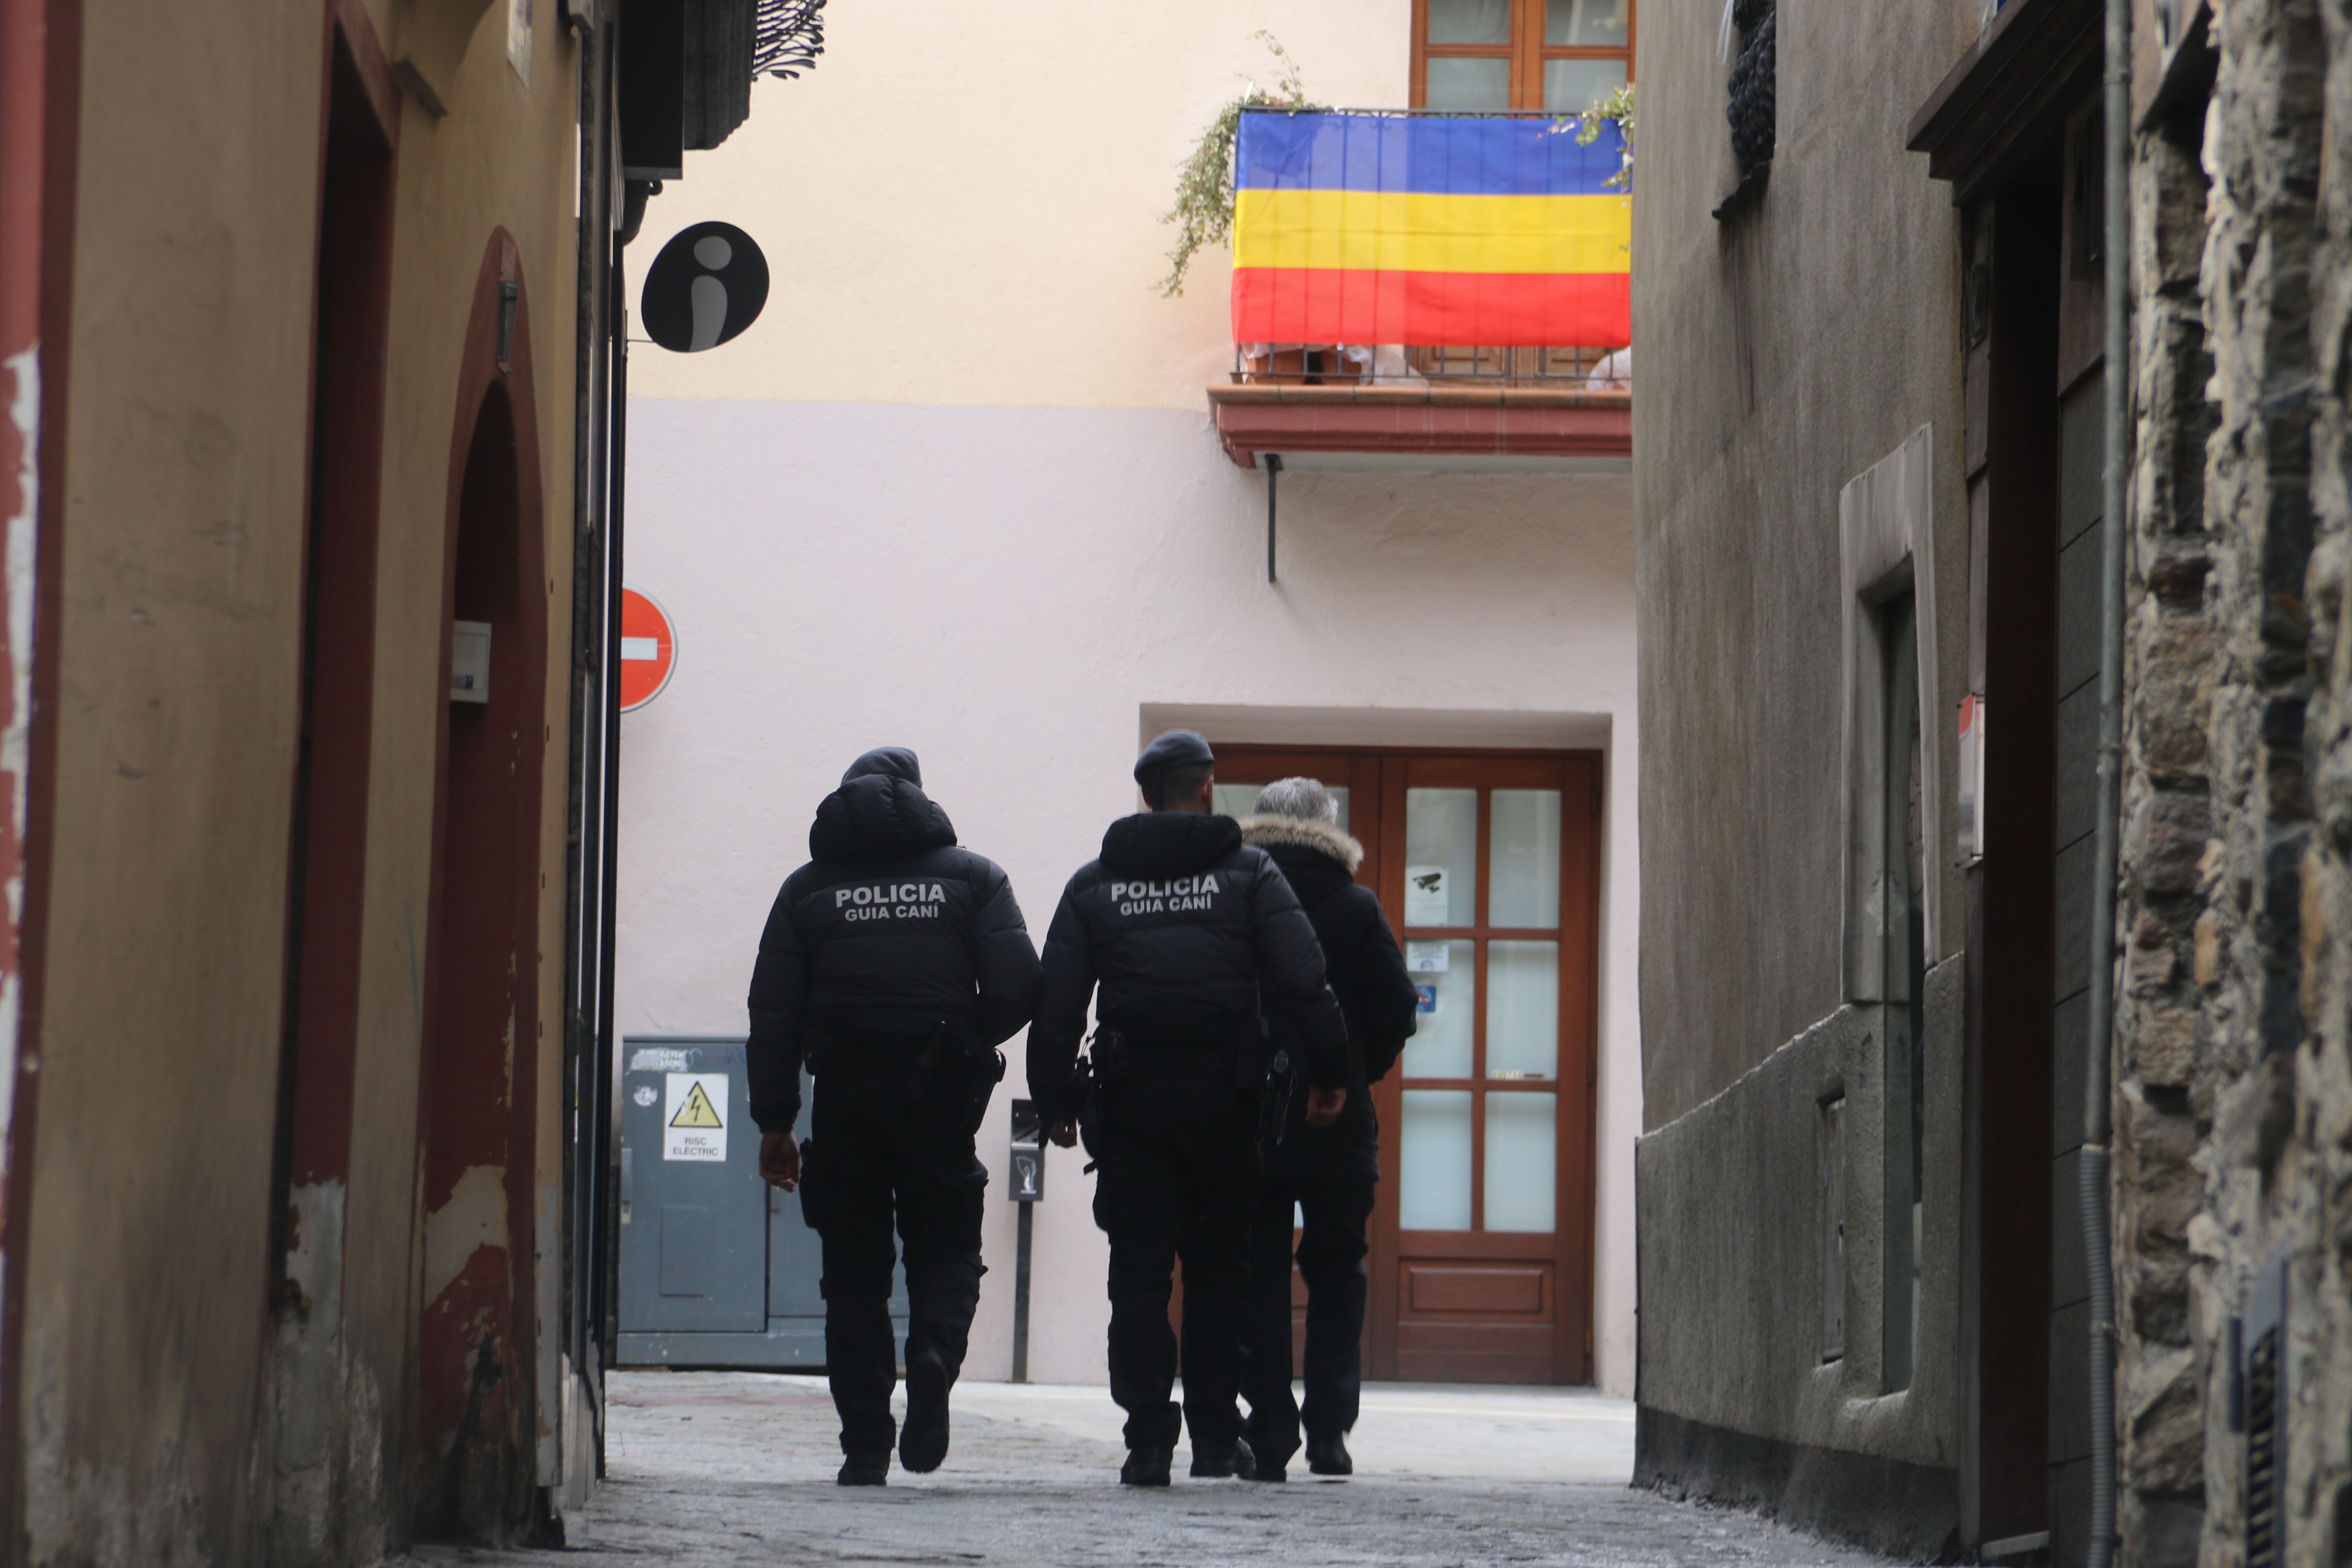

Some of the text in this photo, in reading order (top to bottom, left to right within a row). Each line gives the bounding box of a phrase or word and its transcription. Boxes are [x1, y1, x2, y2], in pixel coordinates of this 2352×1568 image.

[836, 884, 946, 908] POLICIA
[1112, 874, 1219, 902] POLICIA
[845, 906, 890, 922] GUIA
[1121, 898, 1164, 916] GUIA
[685, 1137, 707, 1145] RISC
